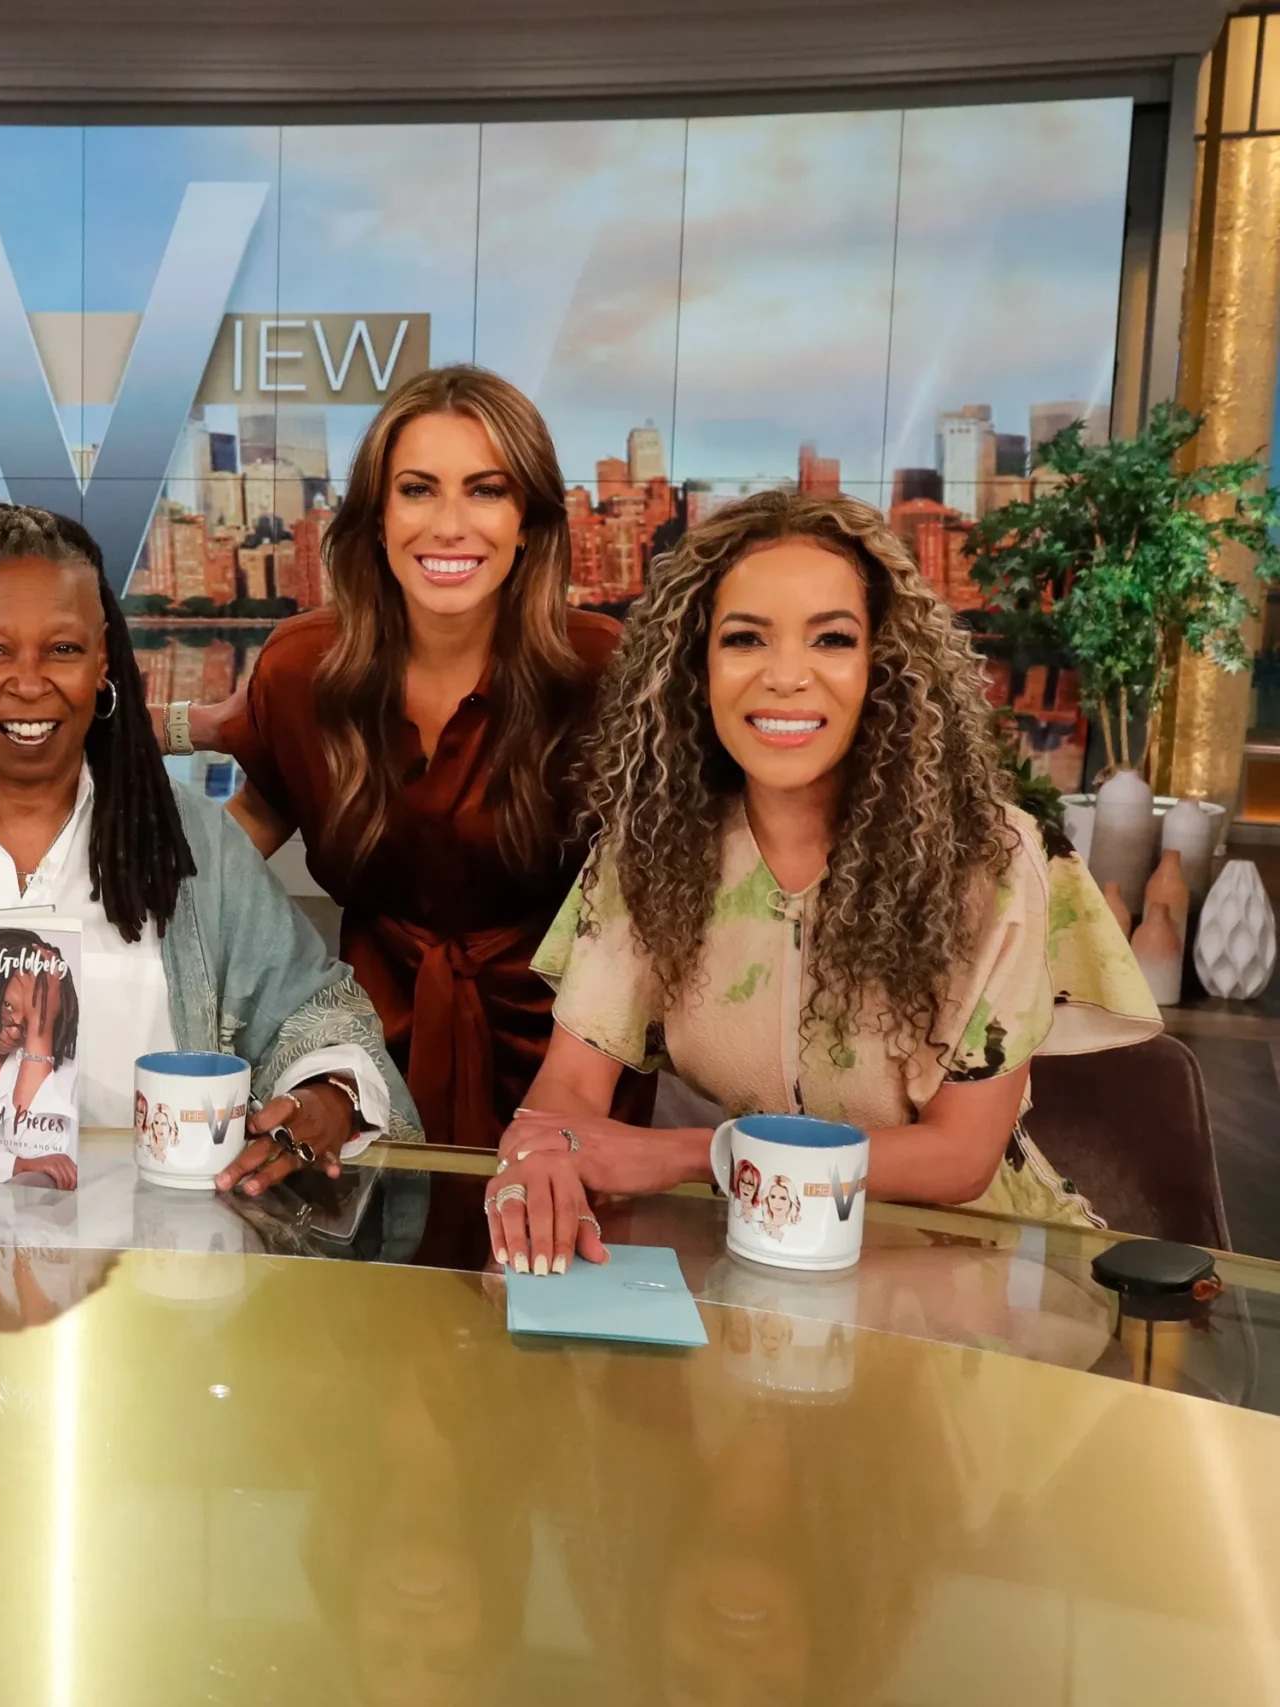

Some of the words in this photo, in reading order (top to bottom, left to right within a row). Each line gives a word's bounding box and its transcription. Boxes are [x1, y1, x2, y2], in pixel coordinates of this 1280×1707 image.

[13, 1105, 65, 1136] Pieces
[182, 1111, 203, 1121] THE
[804, 1184, 829, 1196] THE
